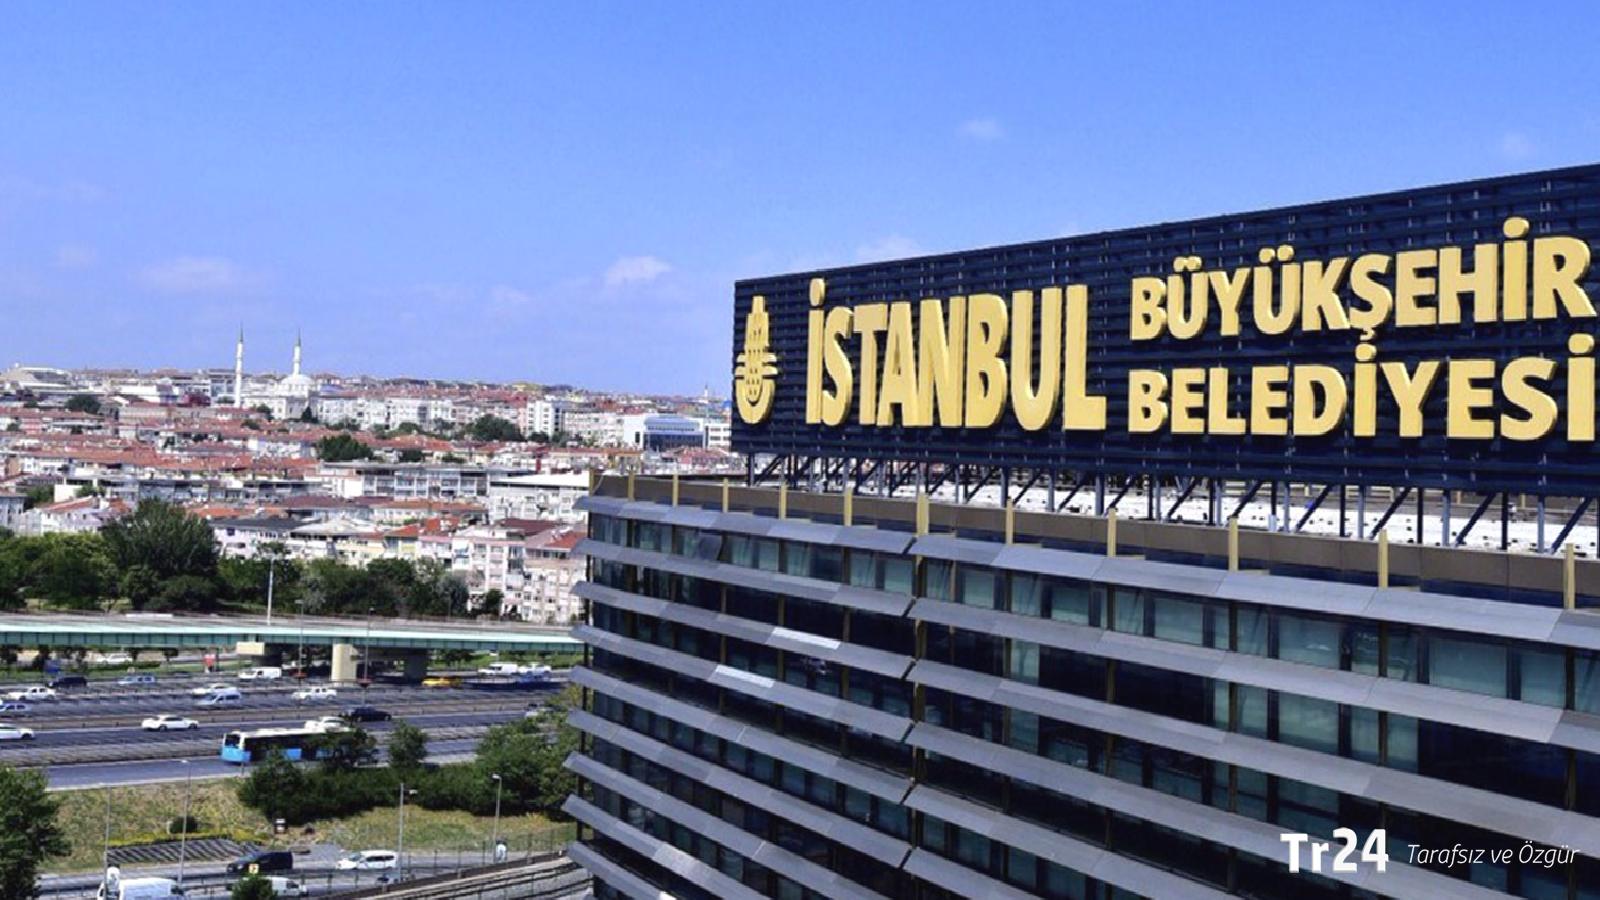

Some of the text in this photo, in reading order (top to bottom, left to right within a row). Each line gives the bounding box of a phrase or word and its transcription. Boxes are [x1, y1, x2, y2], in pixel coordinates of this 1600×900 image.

[1130, 217, 1597, 341] BÜYÜKŞEHİR
[806, 277, 1107, 431] İSTANBUL
[1128, 333, 1595, 441] BELEDİYESİ
